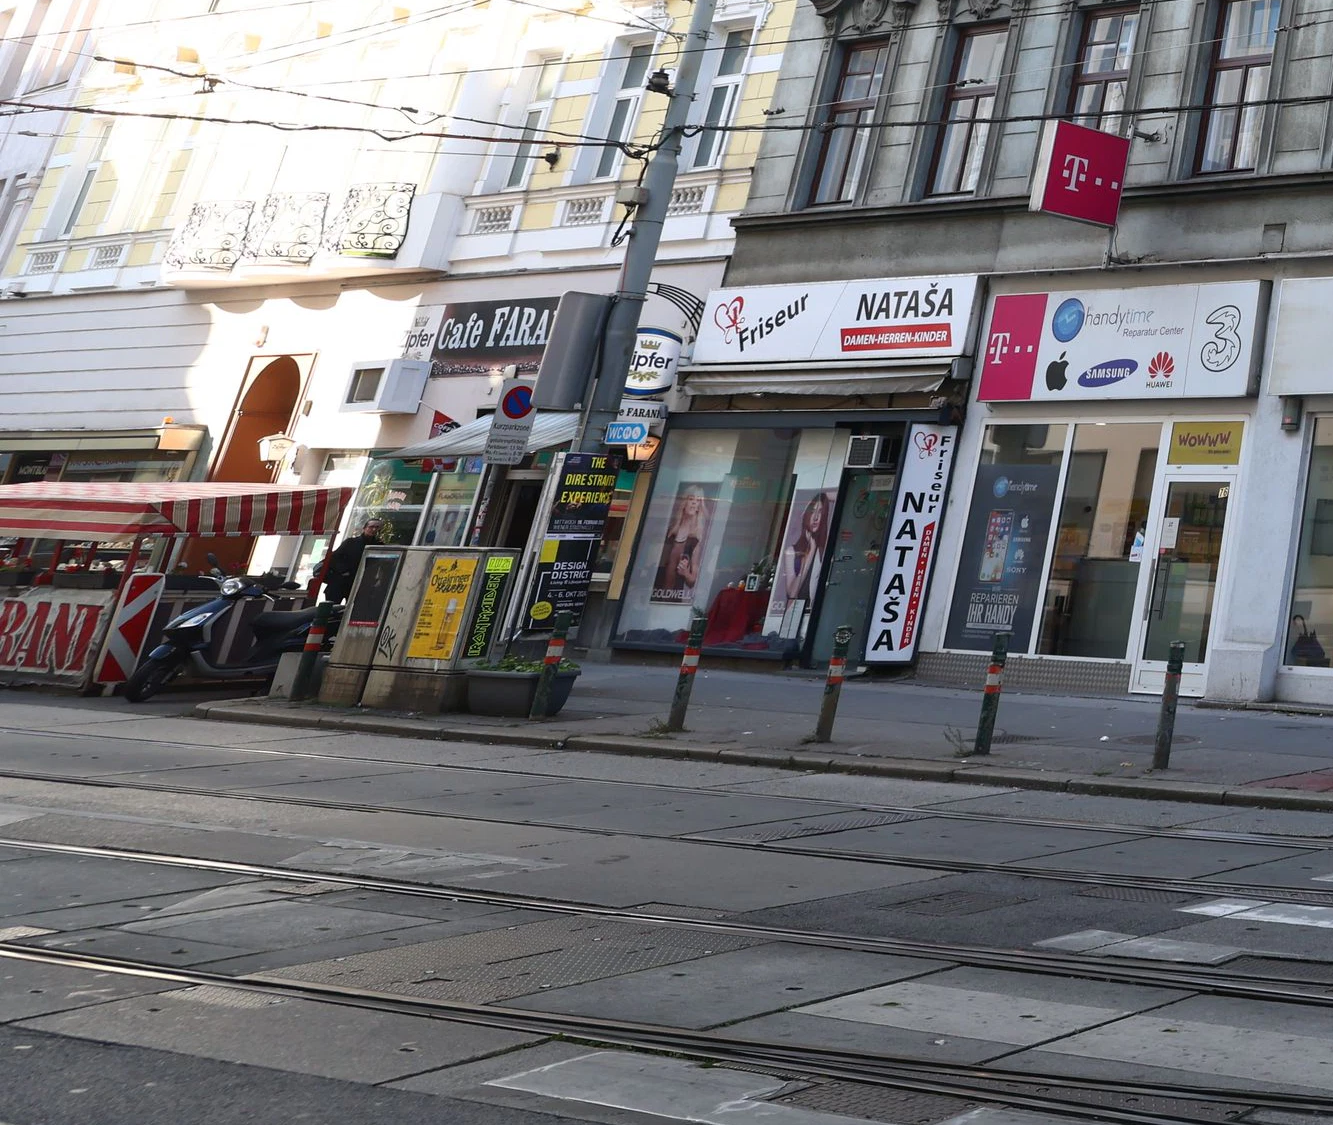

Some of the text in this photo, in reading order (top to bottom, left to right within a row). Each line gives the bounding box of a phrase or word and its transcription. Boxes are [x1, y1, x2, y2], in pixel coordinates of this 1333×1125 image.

[855, 282, 954, 322] NATAŠA
[437, 305, 559, 350] Cafe FARA
[736, 292, 809, 353] Friseur
[1084, 304, 1155, 332] handytime
[842, 329, 948, 348] DAMEN-HERREN-KINDER
[1122, 325, 1184, 338] Reparatur Center
[1200, 304, 1242, 373] 3
[630, 347, 674, 371] ipfer
[1085, 366, 1131, 380] SAMSUNG
[1145, 380, 1173, 389] HUAWEI
[608, 426, 624, 440] WC
[591, 456, 608, 469] THE
[564, 474, 616, 487] DIRE STRAITS
[927, 435, 952, 514] Friseur
[560, 491, 612, 505] EXPERIENCE
[922, 529, 932, 558] DAMEN
[551, 570, 590, 580] DISTRICT
[553, 561, 588, 571] DESIGN
[871, 491, 926, 652] NATAŠA
[1006, 566, 1027, 574] SONY
[476, 573, 505, 625] MAIDEN
[652, 588, 693, 600] GOLDWELL
[970, 592, 1020, 605] REPARIEREN
[966, 602, 1018, 625] IHR HANDY
[903, 608, 916, 644] KINDER
[467, 623, 492, 657] IRON
